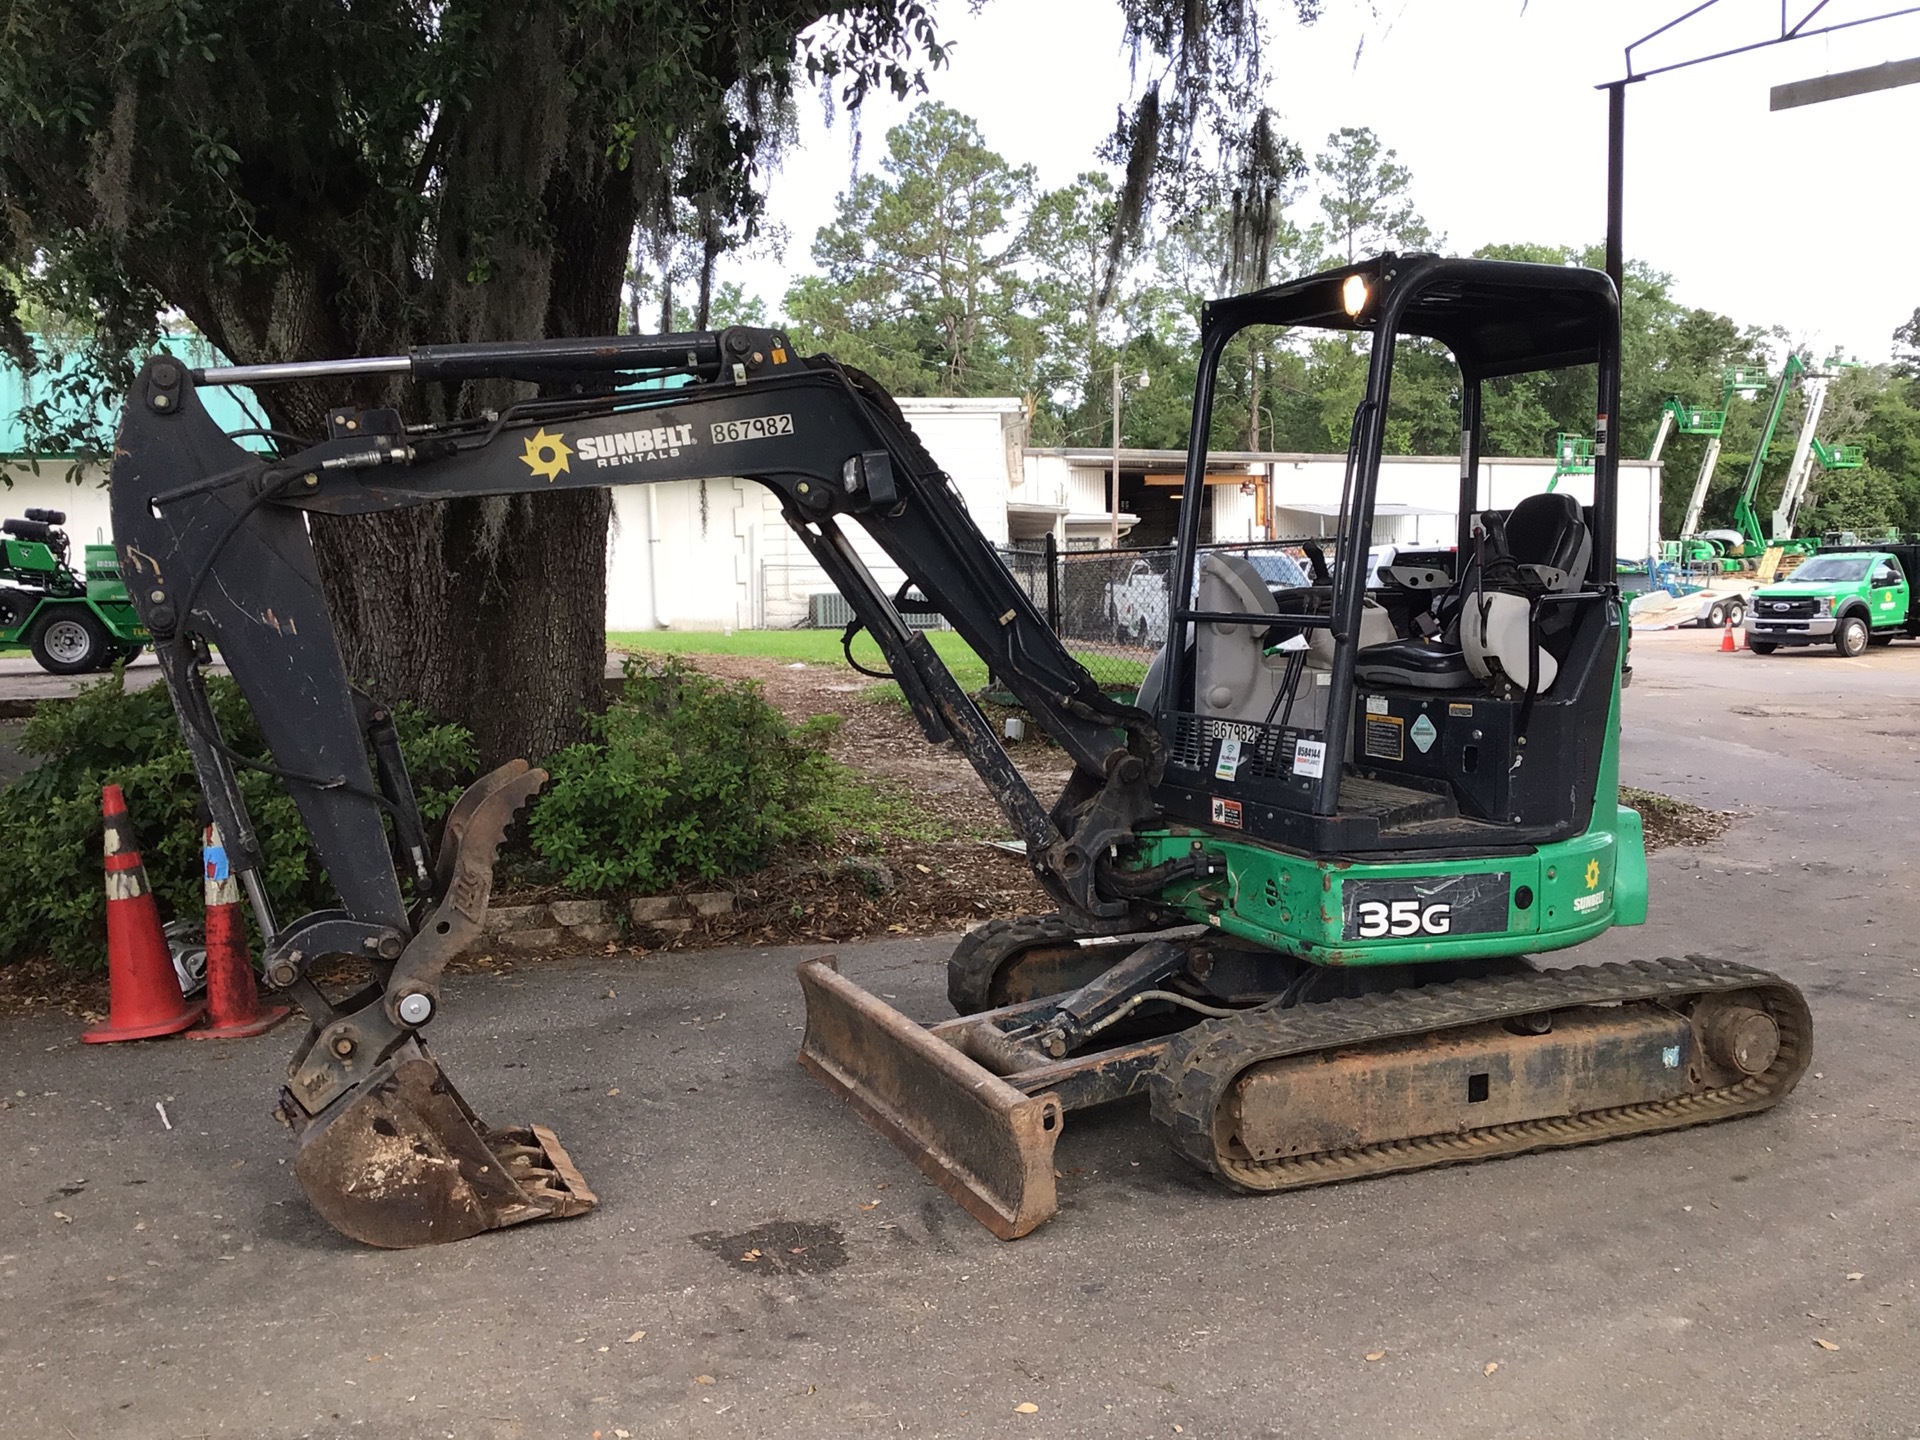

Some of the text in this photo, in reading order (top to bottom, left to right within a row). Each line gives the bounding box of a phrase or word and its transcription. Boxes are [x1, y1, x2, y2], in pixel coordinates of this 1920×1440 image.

[576, 423, 693, 461] SUNBELT
[713, 415, 793, 443] 867982
[596, 448, 681, 468] RENTALS
[1213, 721, 1254, 743] 867982
[1359, 901, 1450, 938] 35G
